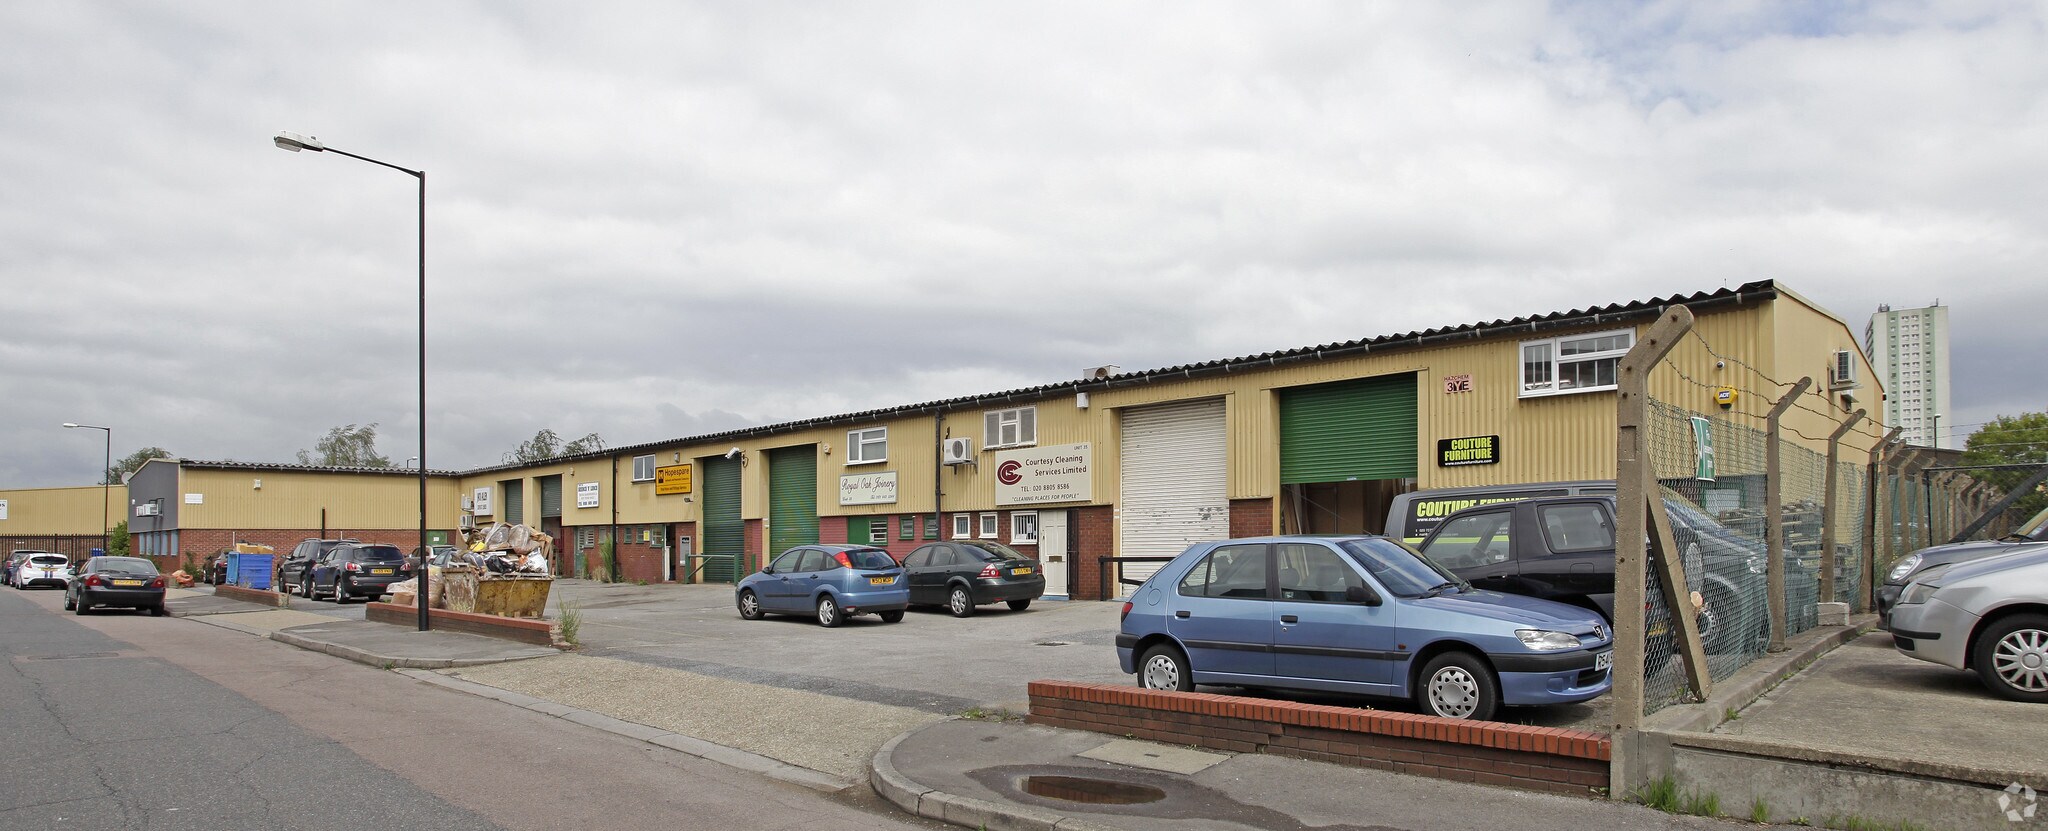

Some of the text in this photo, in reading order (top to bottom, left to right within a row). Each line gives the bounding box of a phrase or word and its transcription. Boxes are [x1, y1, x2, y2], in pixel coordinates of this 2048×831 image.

[1451, 437, 1492, 450] COUTURE
[1055, 455, 1083, 464] Cleaning
[1444, 448, 1492, 462] FURNITURE
[665, 469, 689, 477] Hopespare
[1062, 465, 1087, 474] Limited
[841, 476, 895, 494] Royal Oak Joinery
